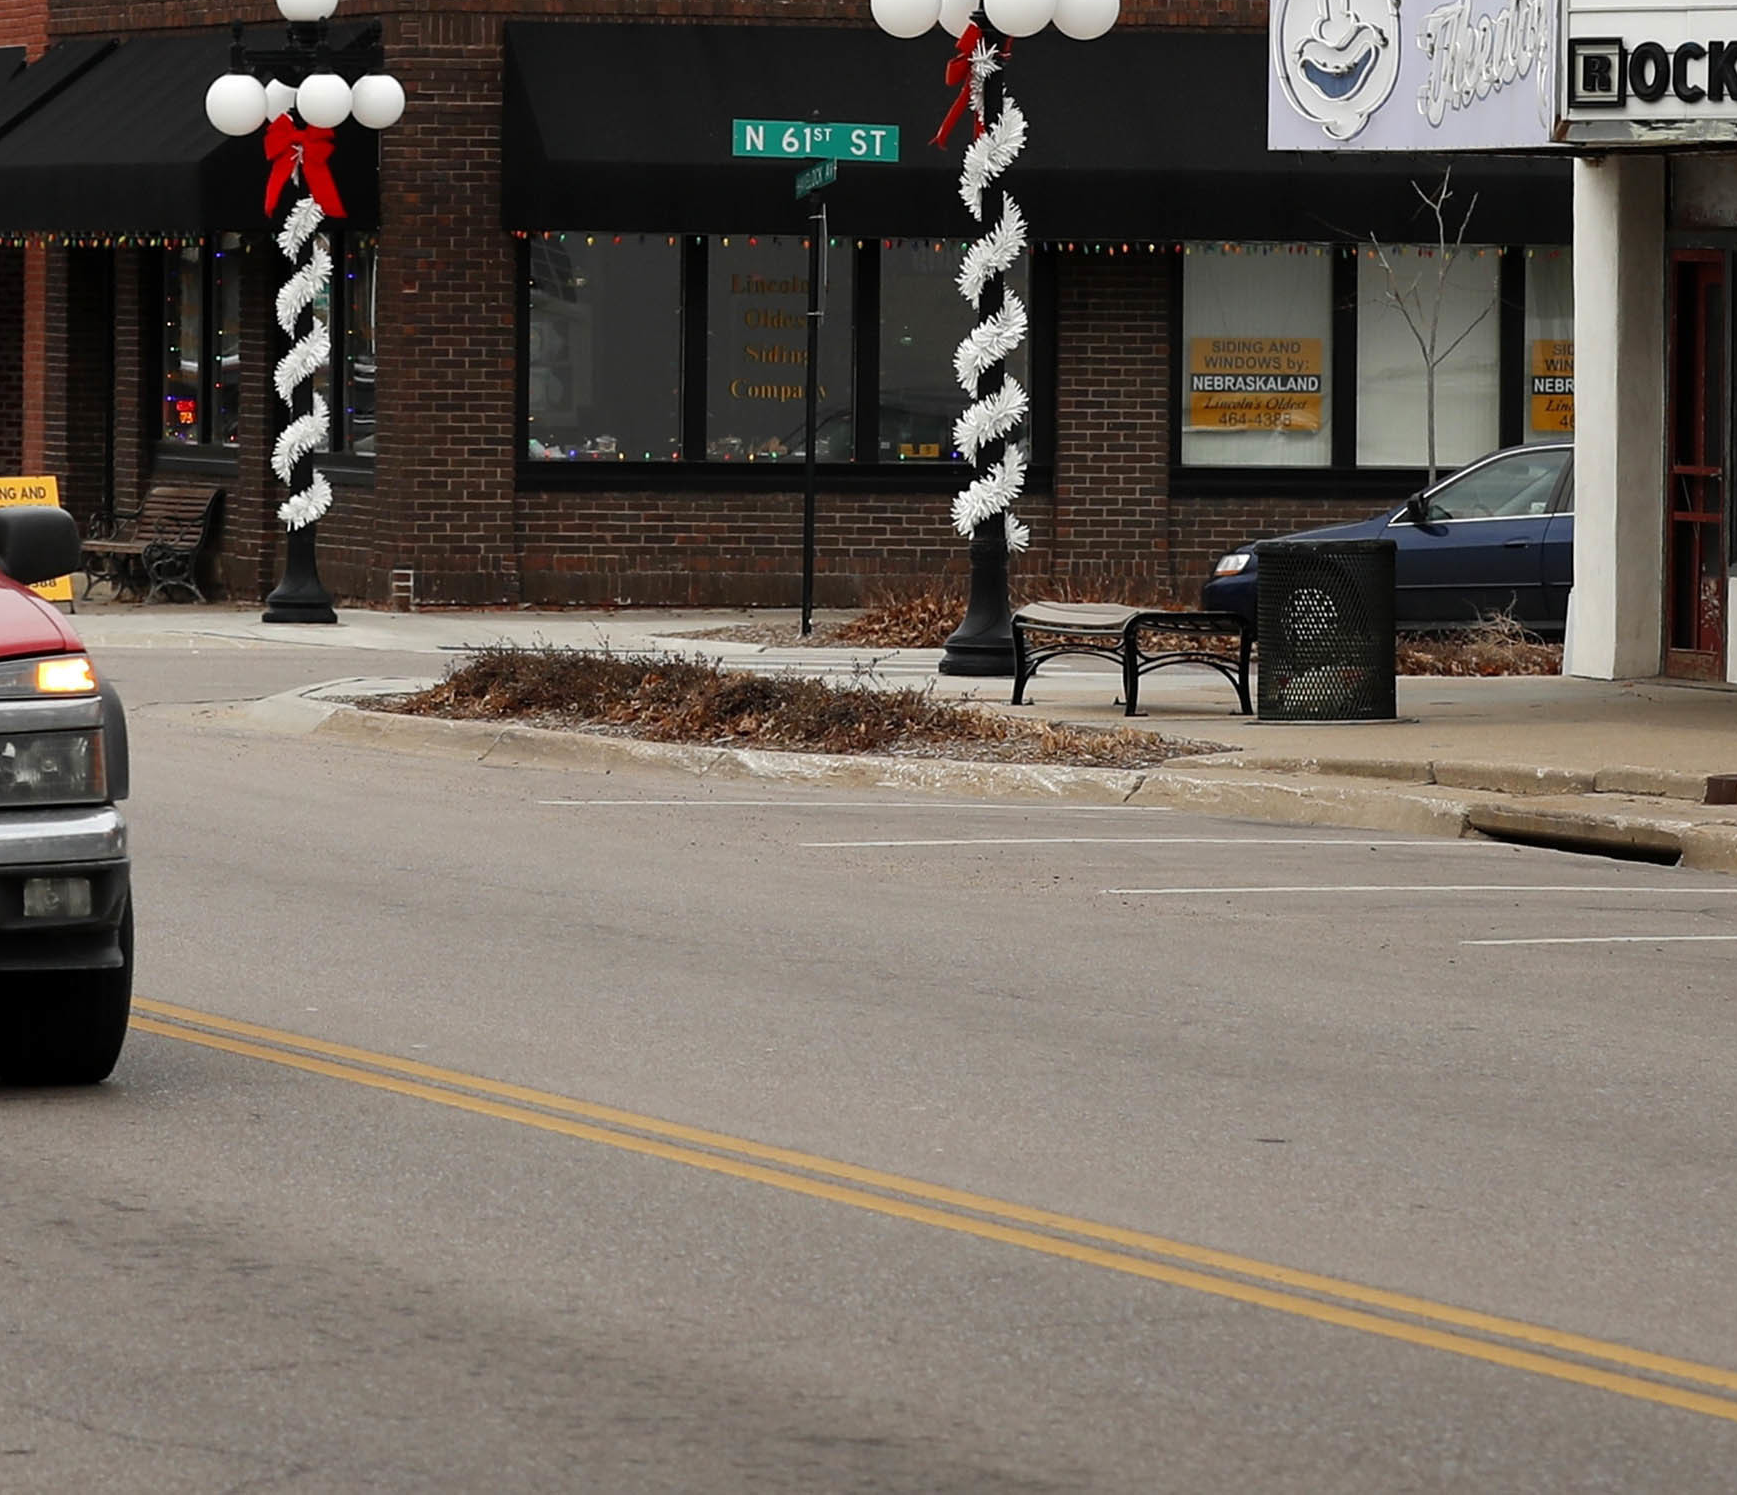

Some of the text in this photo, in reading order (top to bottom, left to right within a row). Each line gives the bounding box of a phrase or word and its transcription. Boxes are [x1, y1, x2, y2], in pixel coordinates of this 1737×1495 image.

[745, 125, 887, 156] N 61ST ST
[744, 310, 807, 330] Oldes
[1212, 341, 1302, 354] SIDING AND
[1204, 356, 1310, 373] WINDOWS by:
[729, 378, 827, 403] Compay
[1192, 375, 1319, 392] NEBRASKALAND
[1204, 395, 1308, 410] Lincoln's Oldest
[20, 486, 47, 500] AND
